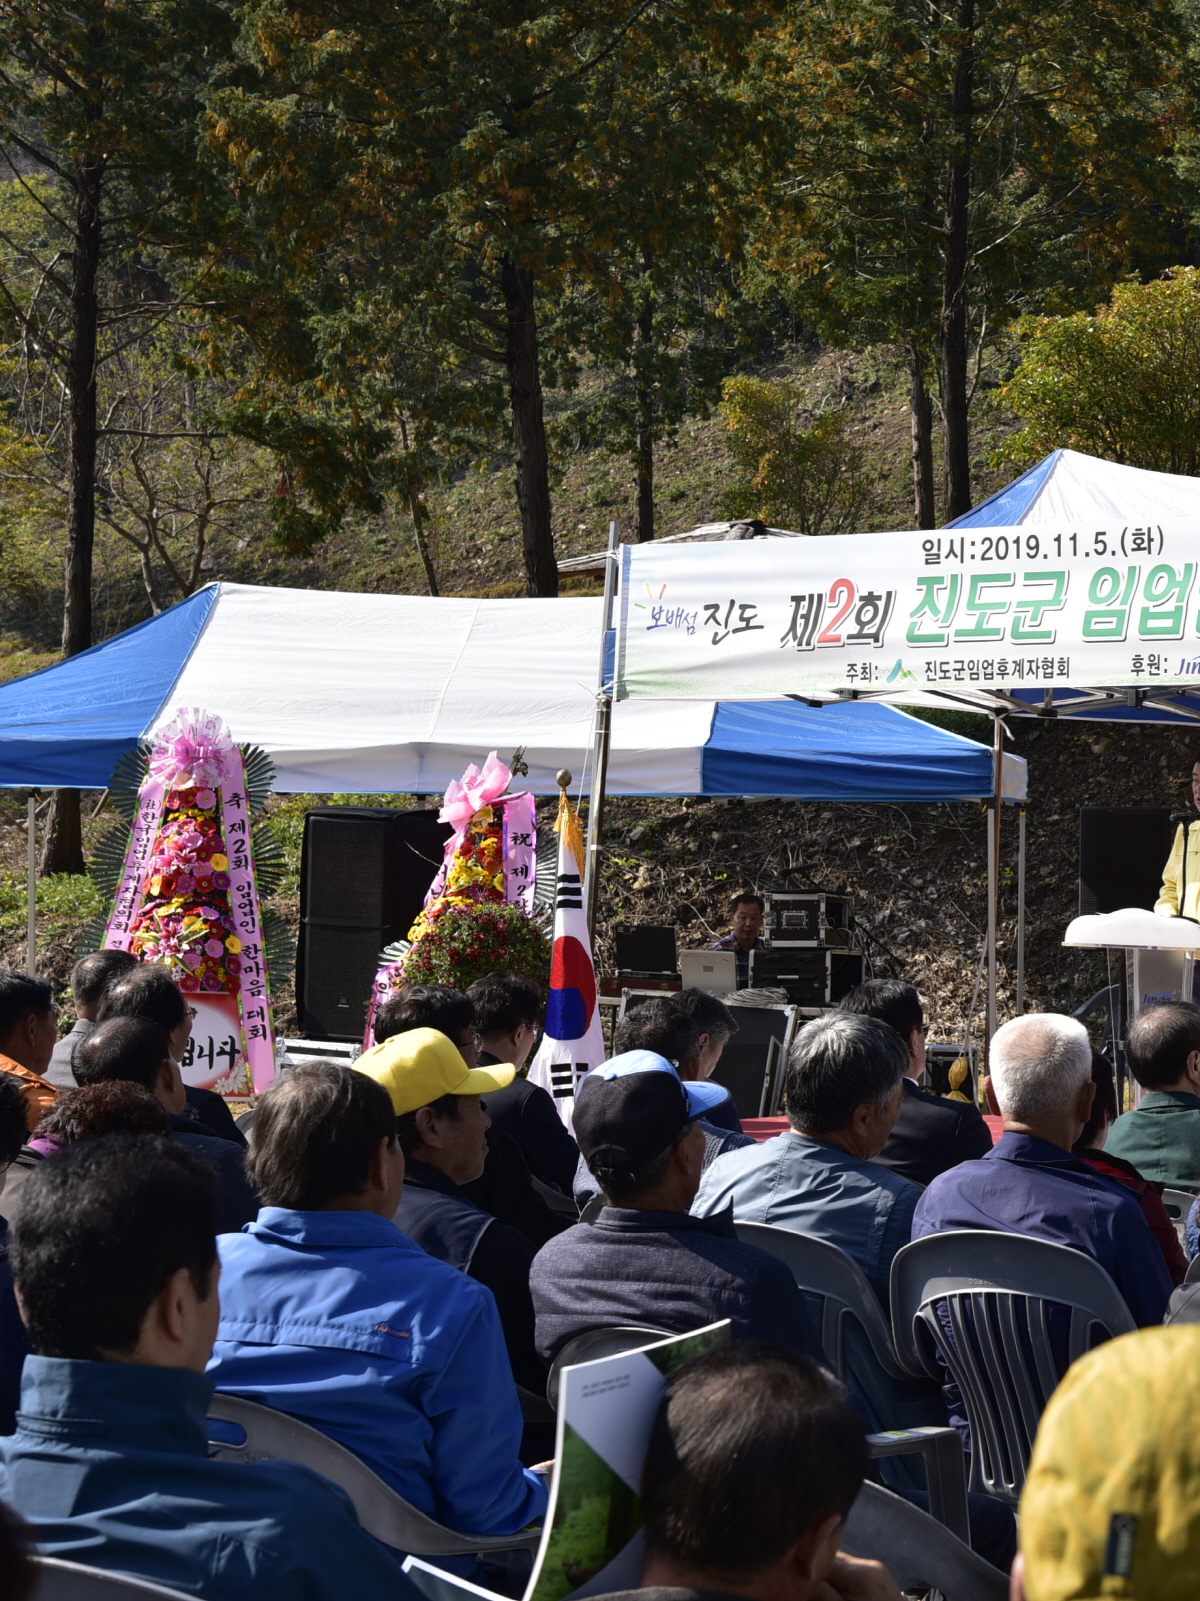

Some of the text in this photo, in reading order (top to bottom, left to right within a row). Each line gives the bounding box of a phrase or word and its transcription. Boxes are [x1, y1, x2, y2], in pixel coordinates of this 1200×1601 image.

[921, 525, 1165, 566] 일시:2019.11.5.(화)
[703, 598, 765, 646] 진도
[780, 577, 897, 652] 제2회
[905, 569, 1070, 649] 진도군
[846, 656, 1071, 684] 주최: 진도군임업후계자협회
[1130, 653, 1169, 678] 후원:
[510, 831, 533, 847] 祝
[225, 791, 268, 1041] 축 제2회 임업인 한마음 대회
